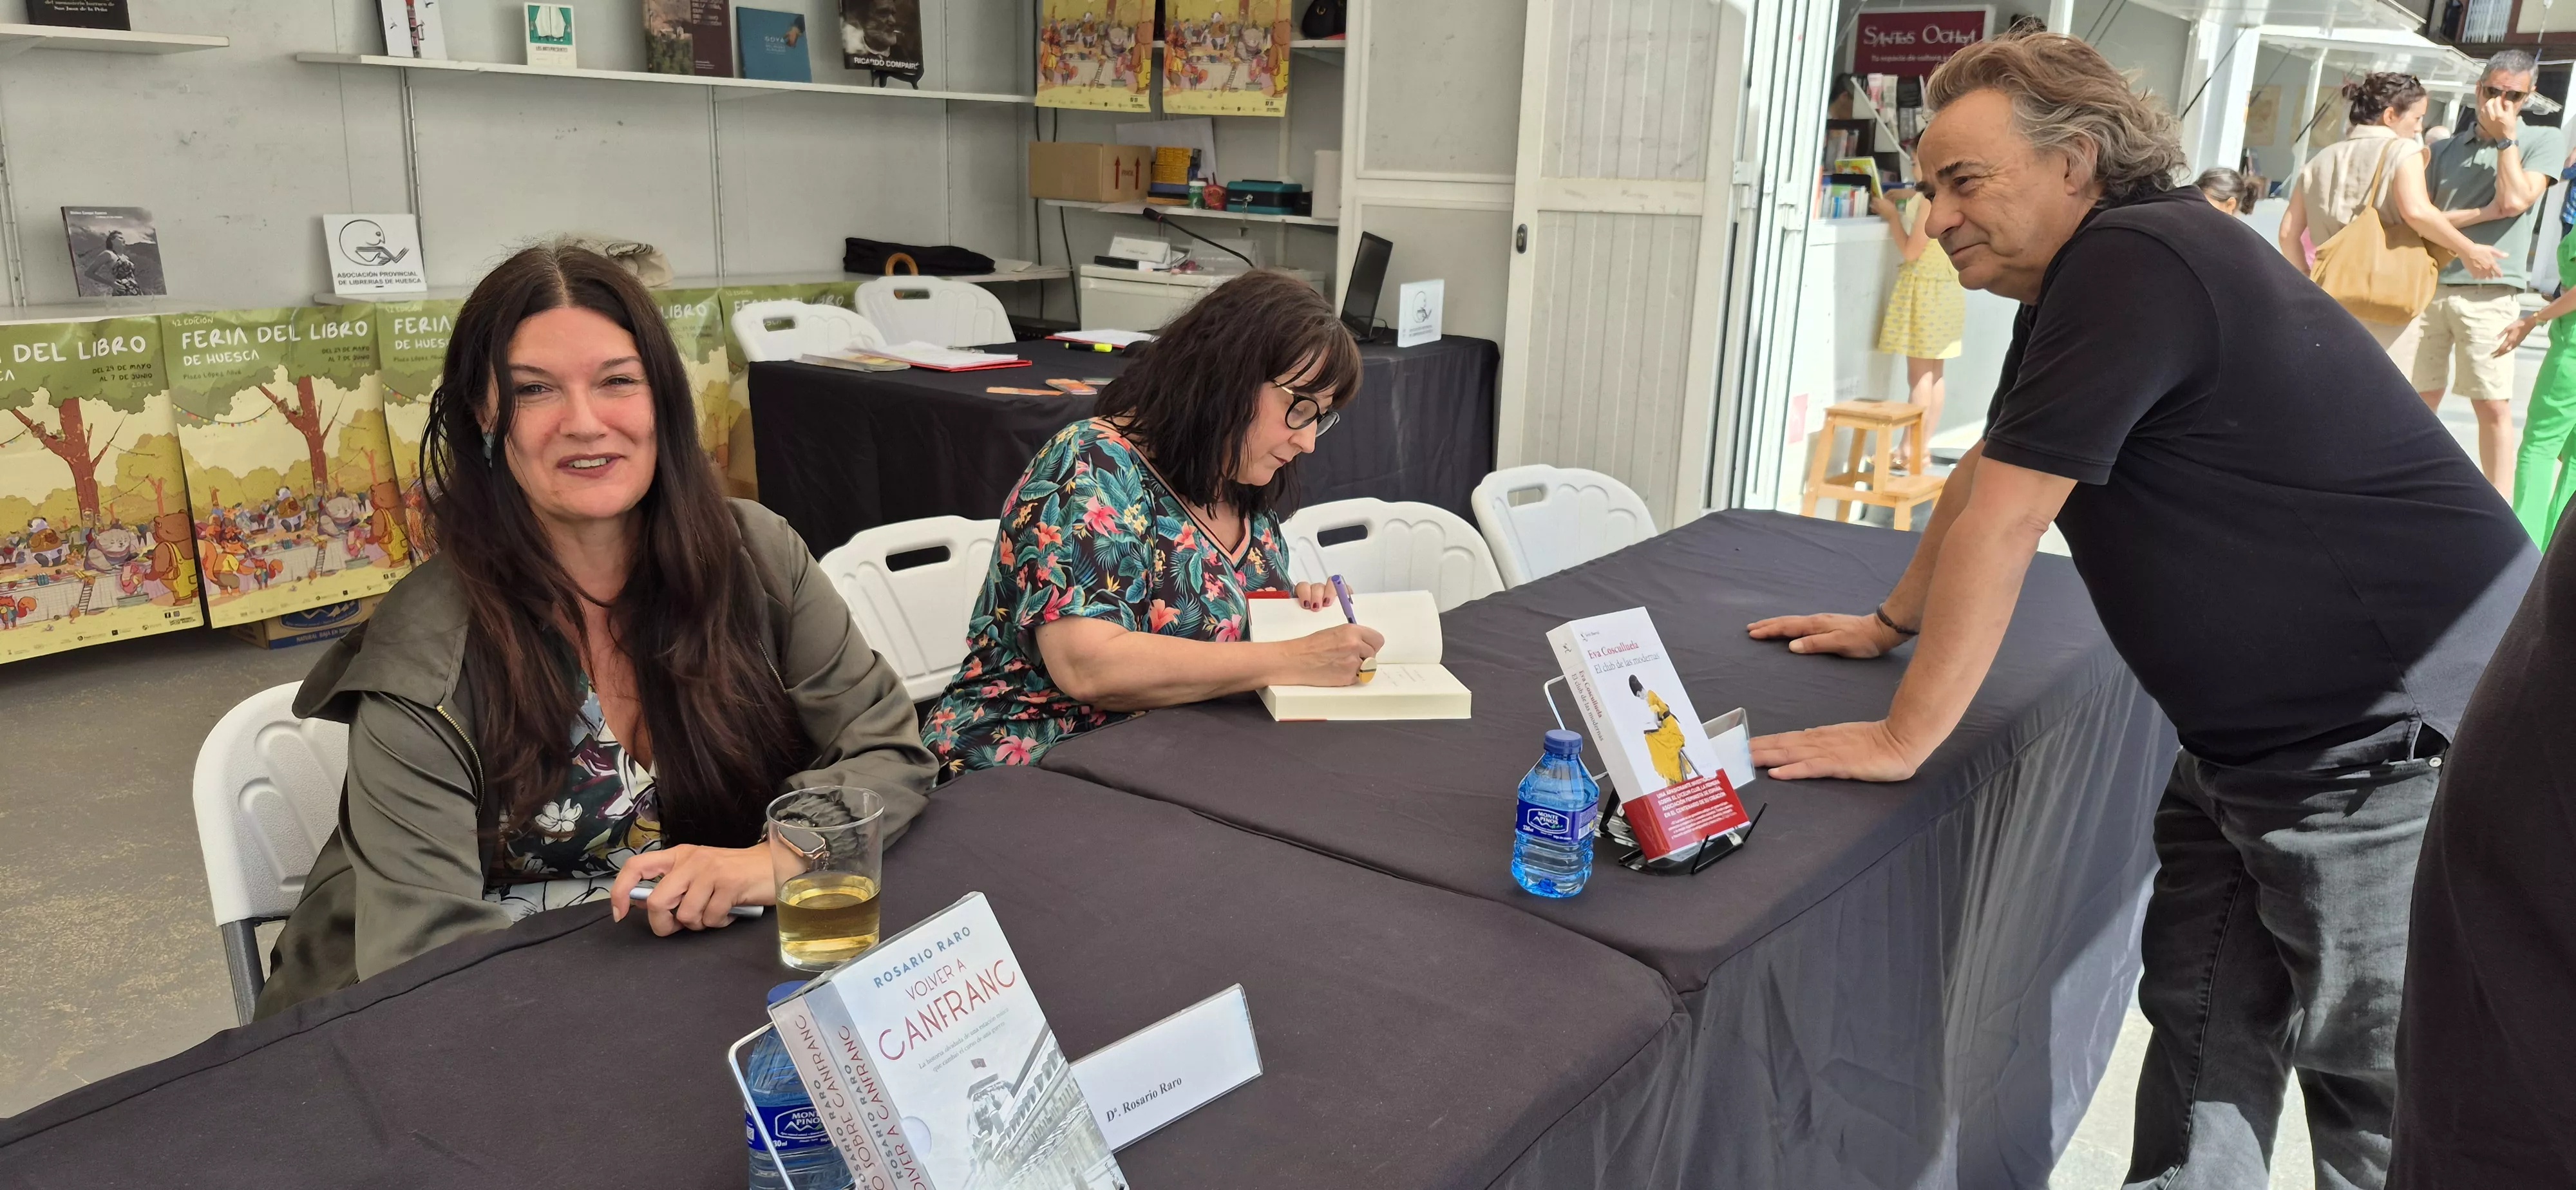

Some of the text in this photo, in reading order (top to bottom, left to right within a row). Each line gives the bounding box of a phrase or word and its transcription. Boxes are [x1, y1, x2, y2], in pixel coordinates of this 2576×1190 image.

[854, 57, 884, 66] RICARDO
[184, 316, 214, 325] EDICIÓN
[394, 315, 451, 335] FERIA
[661, 303, 707, 319] LIBRO
[14, 335, 146, 363] DEL LIBRO
[182, 321, 368, 350] FERIA DEL LIBRO
[395, 338, 449, 350] DE HUES
[184, 348, 260, 366] DE HUESCA
[1587, 640, 1639, 659] Eva Cosculluela
[1594, 652, 1660, 674] El club de las modernas
[1575, 681, 1584, 694] club
[1588, 712, 1604, 741] modernas
[1585, 682, 1602, 718] Cosculluela
[1538, 811, 1558, 820] MONTE
[1540, 816, 1558, 825] PINOS
[873, 926, 971, 989] ROSARIO RARO
[905, 958, 967, 1001] VOLVER A
[878, 959, 1016, 1061] CANFRANC
[918, 1061, 927, 1070] La
[926, 1050, 945, 1064] historia
[944, 1037, 964, 1053] olvidada
[979, 1015, 996, 1030] estación
[795, 1015, 844, 1108] CANFRANC
[933, 1064, 943, 1073] que
[942, 1050, 960, 1066] cambió
[844, 1064, 868, 1105] RARO
[1122, 1090, 1159, 1115] Rosario
[1159, 1077, 1182, 1095] Raro
[791, 1110, 820, 1120] MONT
[796, 1117, 821, 1126] PINO
[838, 1026, 927, 1190] OLVER A CANFRANC
[814, 1080, 871, 1190] ROSARIO RARO
[840, 1112, 876, 1169] SOBRE
[867, 1112, 904, 1180] ROSARIO
